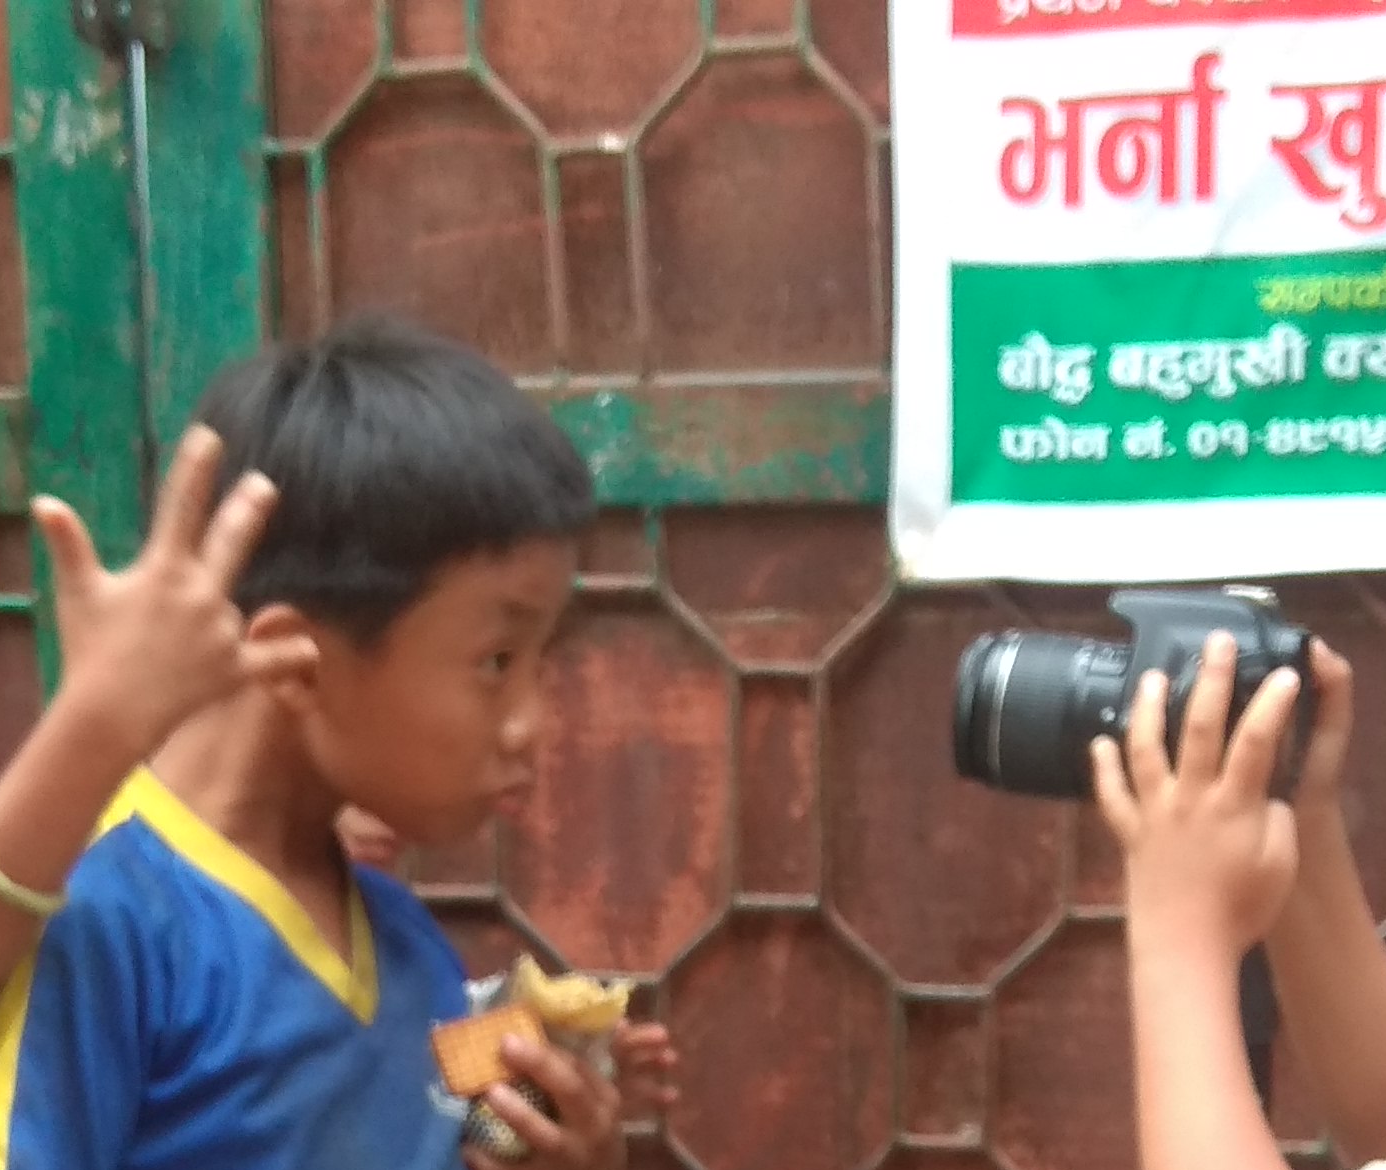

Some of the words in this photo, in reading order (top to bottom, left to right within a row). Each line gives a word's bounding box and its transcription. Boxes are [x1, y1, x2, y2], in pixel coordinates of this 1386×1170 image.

[998, 49, 1227, 207] भर्ना
[1109, 322, 1309, 400] बहुमुखी
[1000, 415, 1110, 460] फोन
